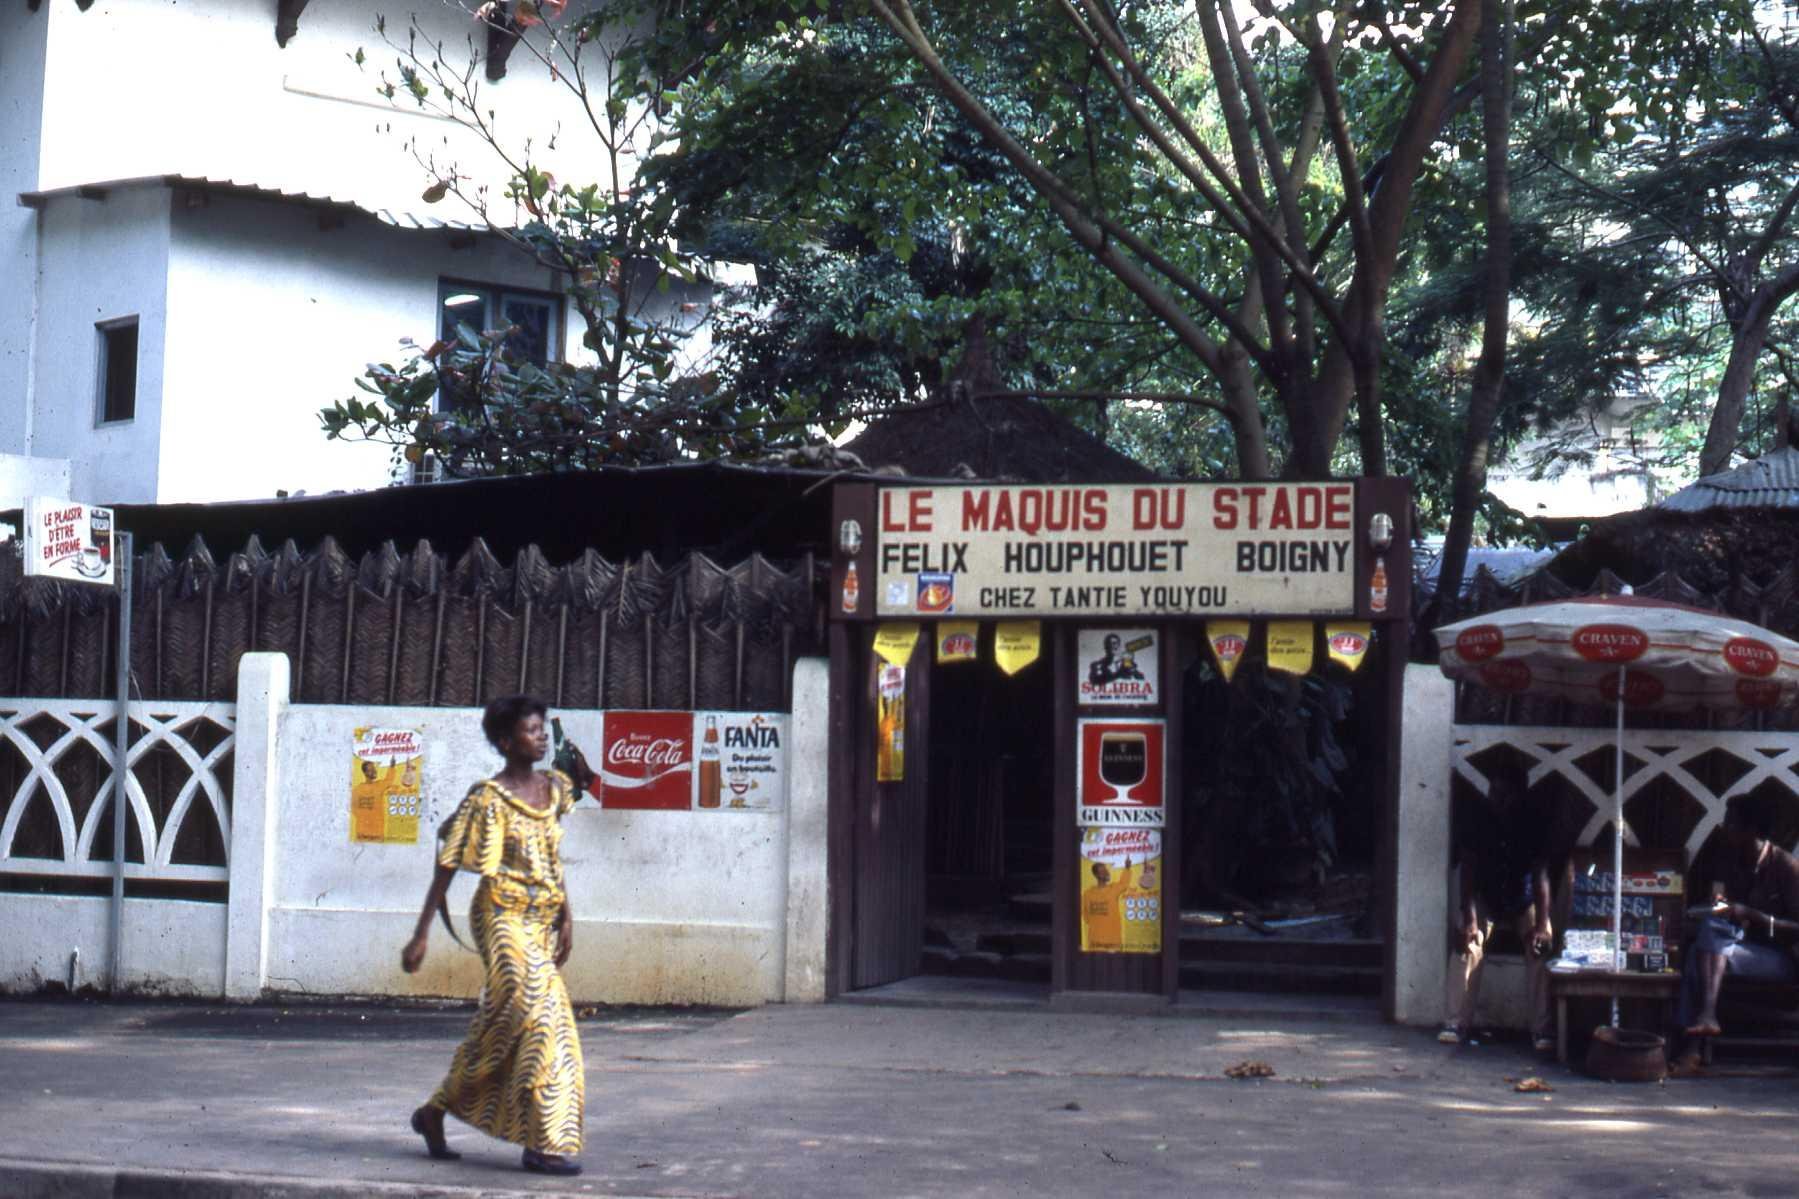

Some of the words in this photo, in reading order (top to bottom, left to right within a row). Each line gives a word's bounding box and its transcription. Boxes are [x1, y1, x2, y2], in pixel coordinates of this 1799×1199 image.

[44, 512, 52, 526] LE
[54, 506, 83, 524] PLAISIR
[883, 490, 933, 532] LE
[962, 489, 1108, 535] MAQUIS
[1133, 488, 1185, 529] DU
[1213, 487, 1350, 530] STADE
[43, 545, 53, 559] EN
[55, 538, 81, 557] FORME
[882, 543, 968, 574] FELIX
[1004, 540, 1189, 573] HOUPHOUET
[1236, 541, 1351, 573] BOIGNY
[980, 587, 1035, 609] CHEZ
[1049, 586, 1127, 609] TANTIE
[1140, 585, 1228, 609] YOUYOU
[1578, 633, 1643, 646] CRAVEN
[1728, 645, 1775, 660] CRAVEN
[1081, 681, 1153, 695] SOLIBRA
[374, 732, 414, 744] GAGNEZ
[725, 722, 780, 748] FANTA
[732, 754, 744, 763] Du
[1082, 808, 1163, 823] GUINNESS
[1105, 831, 1150, 844] GAGNEZ
